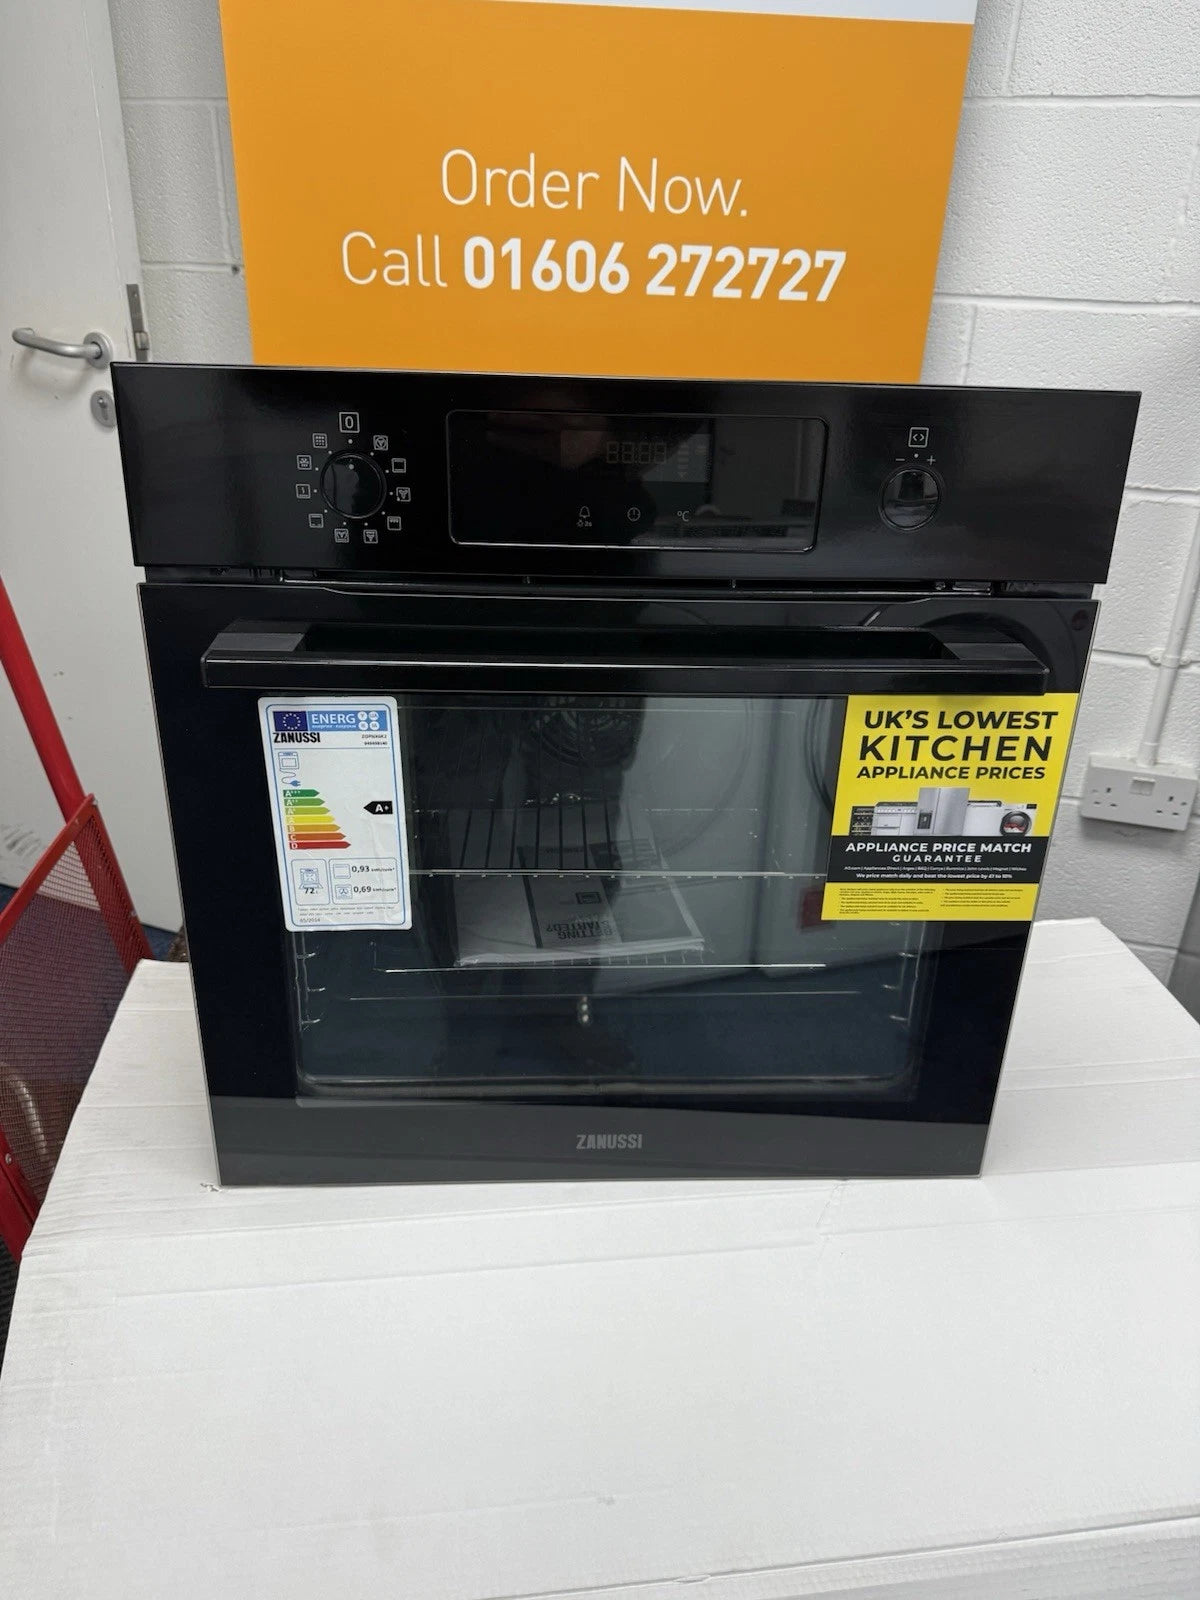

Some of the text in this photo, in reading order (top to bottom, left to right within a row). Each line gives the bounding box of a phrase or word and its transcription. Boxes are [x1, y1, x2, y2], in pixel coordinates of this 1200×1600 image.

[441, 148, 748, 217] Order Now.
[341, 230, 847, 302] Call 01606 272727
[311, 713, 356, 724] ENERG
[938, 711, 1058, 730] LOWEST
[273, 732, 321, 743] ZANUSSI
[859, 735, 1052, 761] KITCHEN
[857, 766, 1046, 779] APPLIANCE PRICES
[375, 804, 389, 812] A+
[846, 843, 1031, 853] APPLIANCE PRICE MATCH
[893, 855, 982, 863] GUARANTEE
[351, 865, 370, 873] 0,93
[576, 1133, 643, 1150] ZANUSSI
